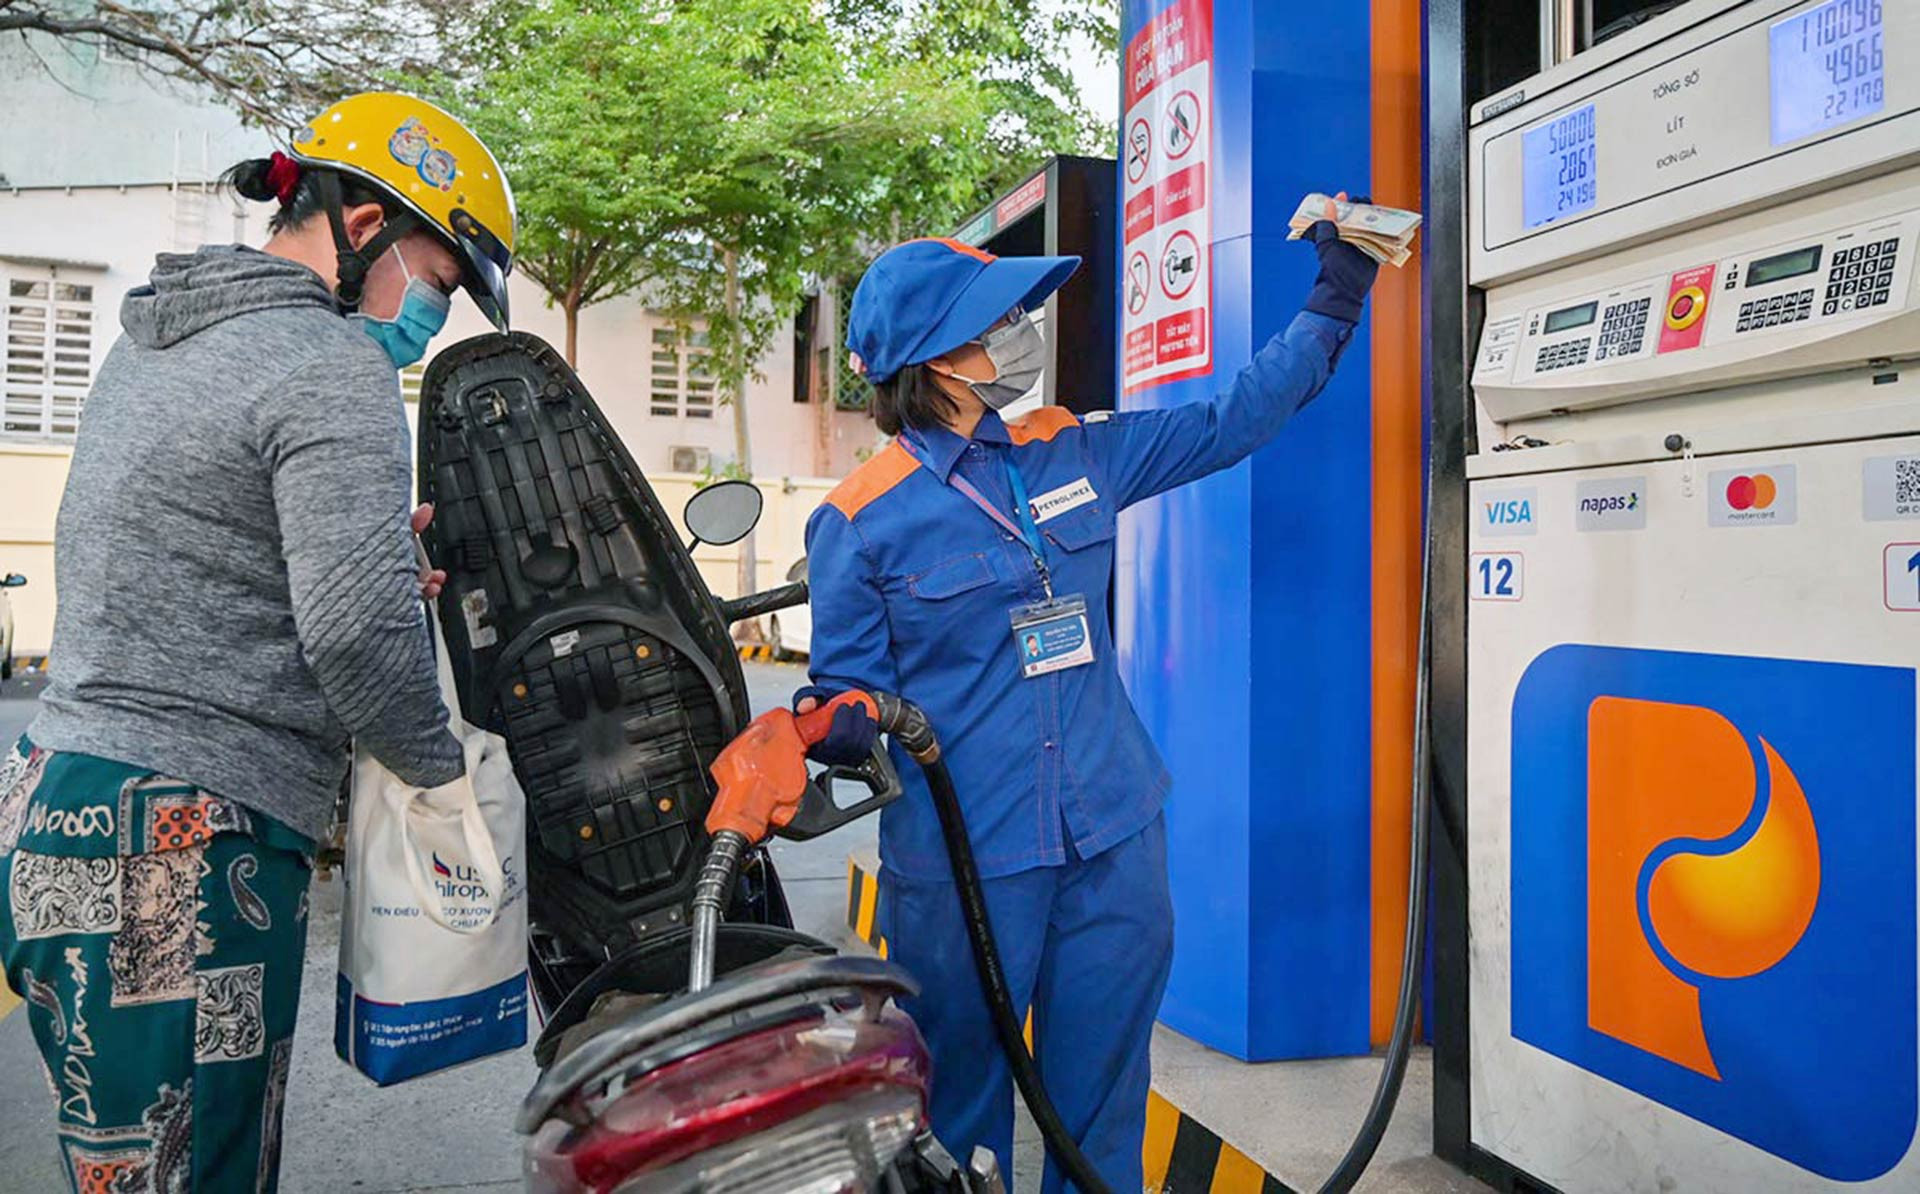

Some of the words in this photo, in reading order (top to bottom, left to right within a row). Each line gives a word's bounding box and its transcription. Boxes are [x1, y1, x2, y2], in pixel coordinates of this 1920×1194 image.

[1667, 115, 1685, 133] LÍT
[1868, 244, 1878, 256] 9
[1848, 265, 1858, 277] 5
[1865, 261, 1875, 273] 6
[1845, 281, 1855, 294] 2
[1861, 278, 1871, 290] 3
[1825, 301, 1835, 314] 0
[1038, 486, 1090, 511] PETROLIMEX
[1581, 495, 1625, 516] napas
[1485, 500, 1532, 524] VISA
[1728, 511, 1776, 520] mastercard
[1896, 505, 1910, 514] QR
[1912, 505, 1920, 514] C
[1479, 558, 1513, 595] 12
